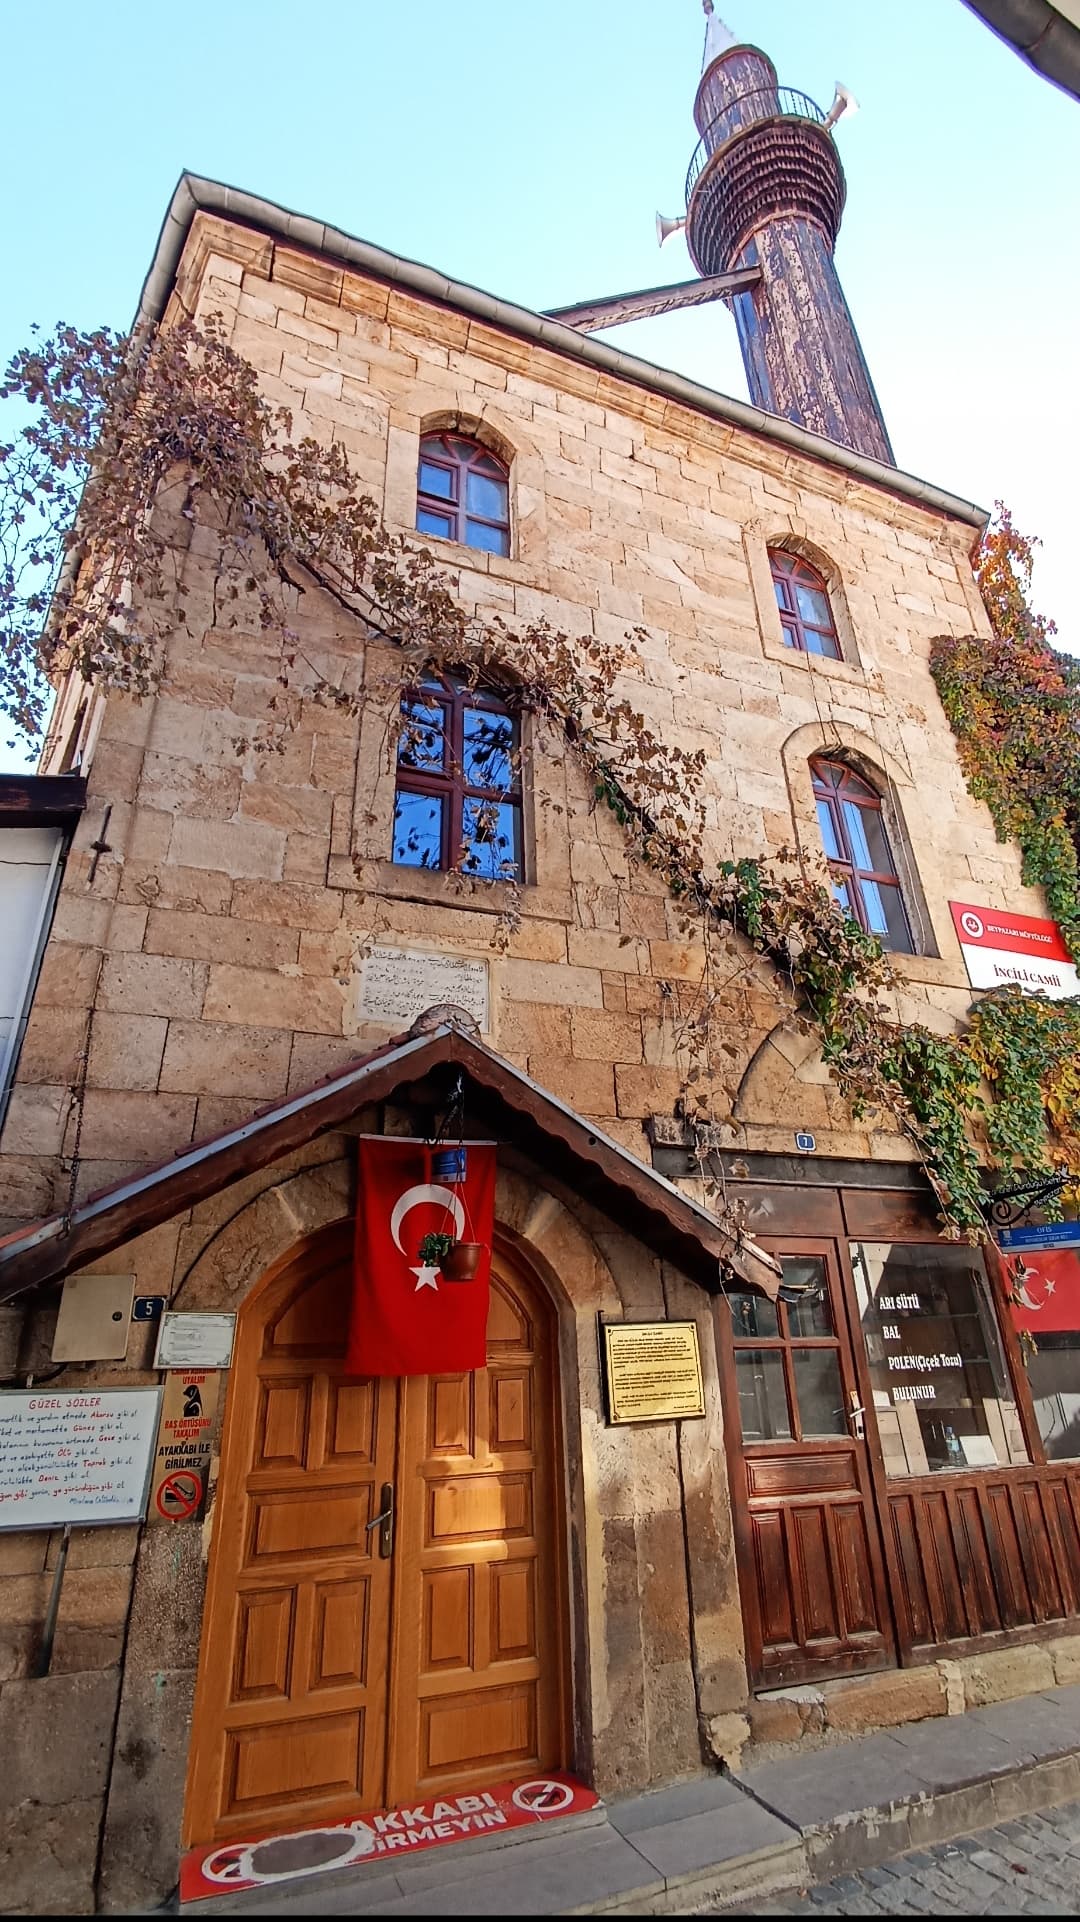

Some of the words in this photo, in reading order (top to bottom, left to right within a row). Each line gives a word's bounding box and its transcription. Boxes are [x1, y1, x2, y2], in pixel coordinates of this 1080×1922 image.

[993, 964, 1028, 982] İNCİLİ
[1029, 972, 1061, 987] CAMİİ
[145, 1301, 154, 1316] 5
[880, 1296, 895, 1310] ARI
[896, 1293, 920, 1309] SÜTÜ
[882, 1325, 901, 1339] BAL
[182, 1375, 206, 1385] UYALIM
[892, 1385, 936, 1400] BULUNUR
[29, 1398, 62, 1410] GÜZEL
[173, 1428, 200, 1439] TAKALIM
[158, 1443, 197, 1457] AYAKKABI
[198, 1441, 211, 1454] İLE
[164, 1456, 202, 1470] GİRİLMEZ
